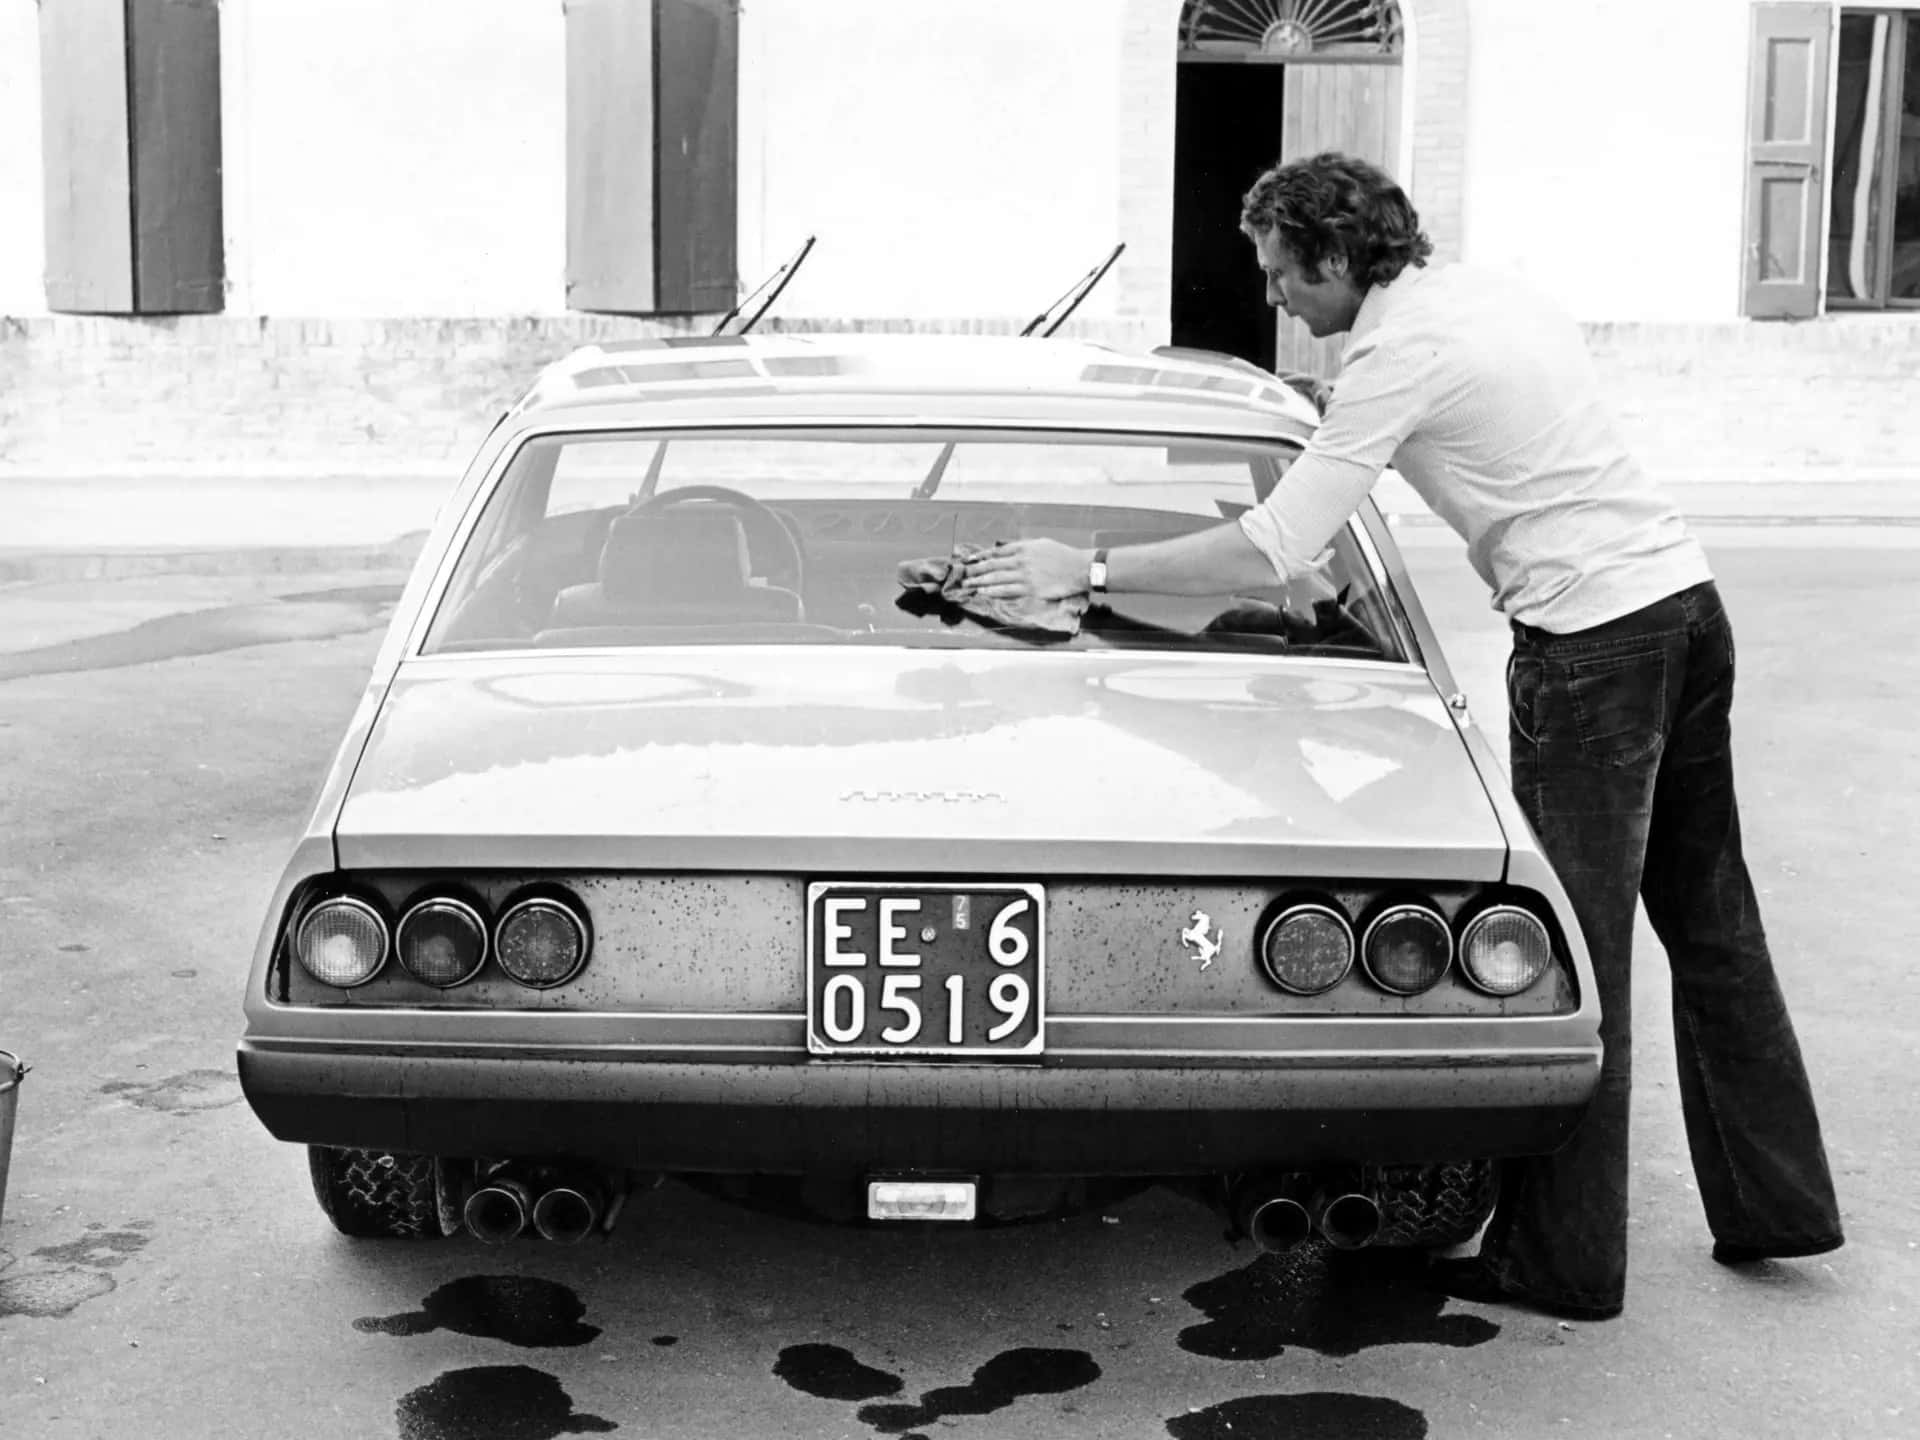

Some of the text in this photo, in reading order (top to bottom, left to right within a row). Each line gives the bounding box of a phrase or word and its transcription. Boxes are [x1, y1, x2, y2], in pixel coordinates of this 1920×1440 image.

[825, 898, 1029, 967] EE 6
[823, 973, 1030, 1043] 0519
